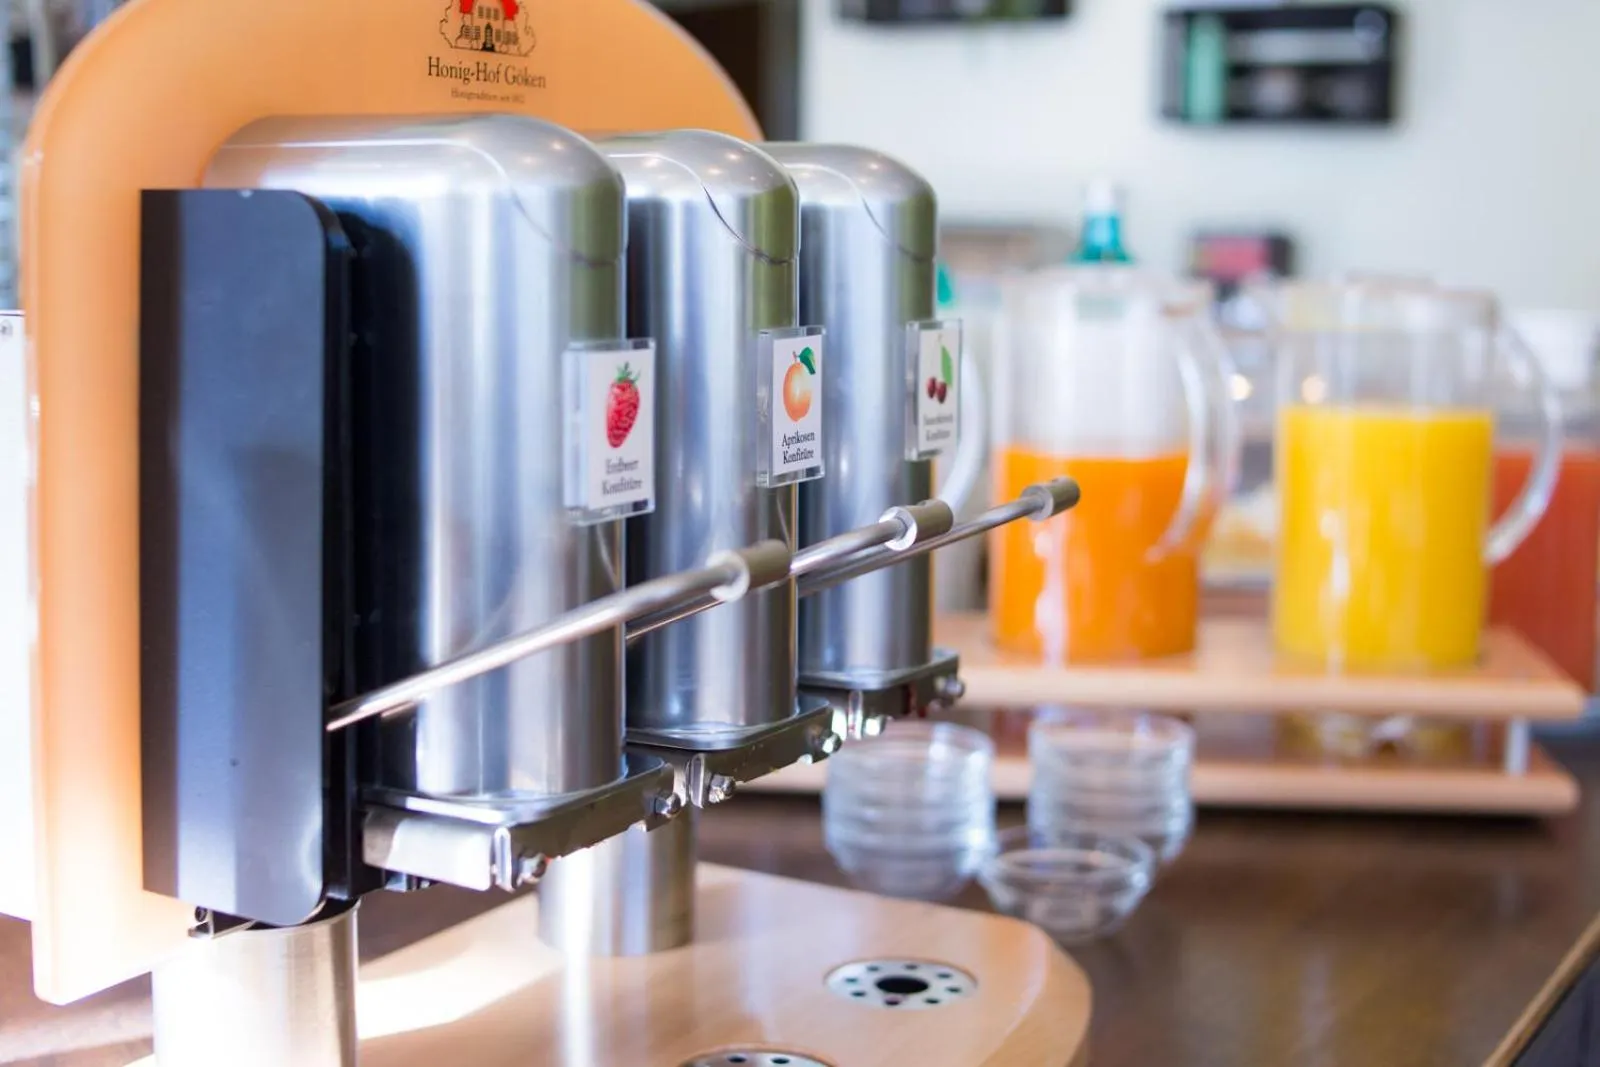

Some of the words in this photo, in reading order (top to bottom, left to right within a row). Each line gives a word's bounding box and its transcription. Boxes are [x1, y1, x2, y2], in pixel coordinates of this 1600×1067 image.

[427, 56, 502, 85] Honig-Hof
[504, 65, 547, 89] Göken
[782, 430, 815, 449] Aprikosen
[783, 448, 815, 464] Konfitüre
